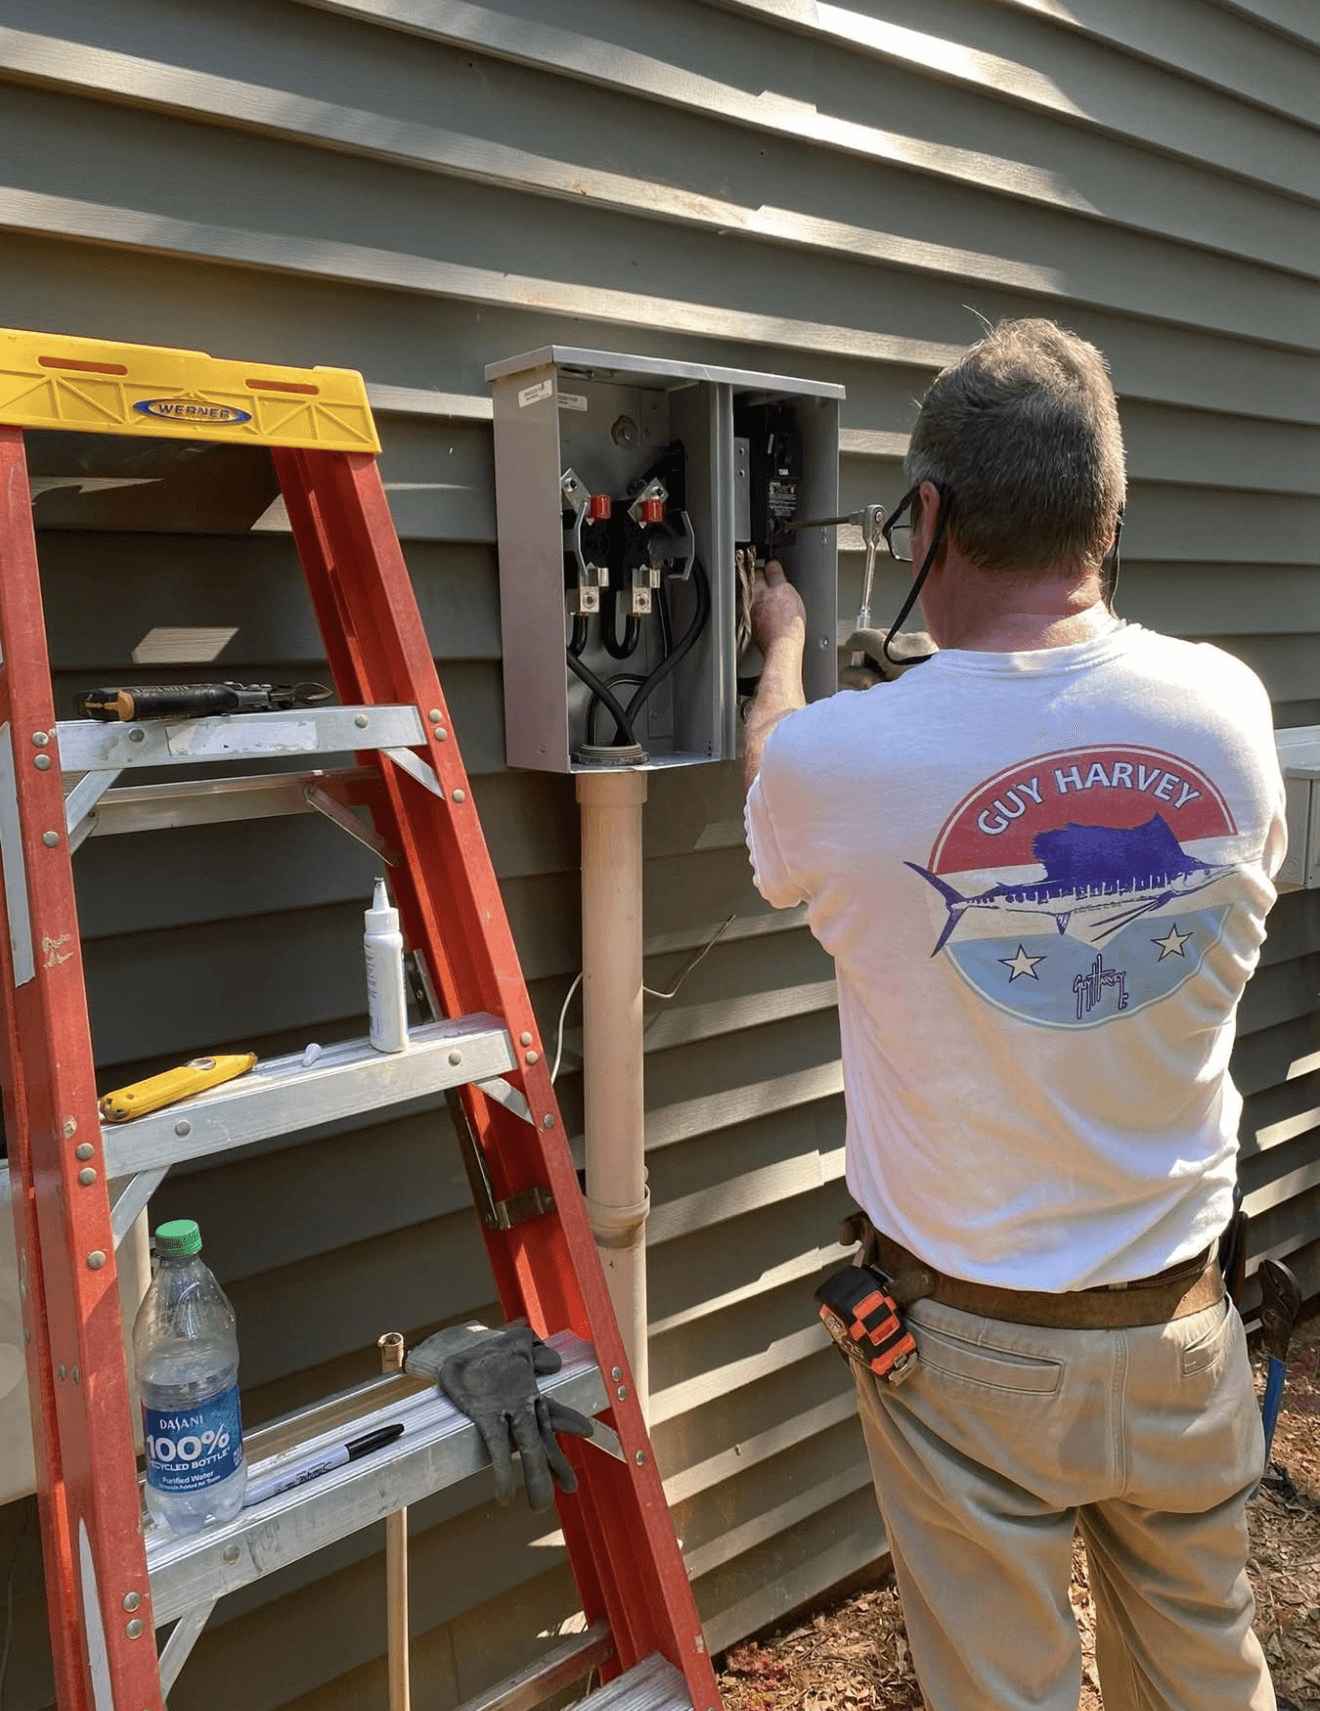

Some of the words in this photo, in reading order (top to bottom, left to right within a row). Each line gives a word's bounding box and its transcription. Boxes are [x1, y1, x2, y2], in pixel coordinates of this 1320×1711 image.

[158, 404, 230, 418] WERNER
[976, 776, 1045, 836] GUY
[1053, 761, 1202, 811] HARVEY
[160, 1415, 204, 1431] DASANI
[146, 1423, 230, 1462] 100%
